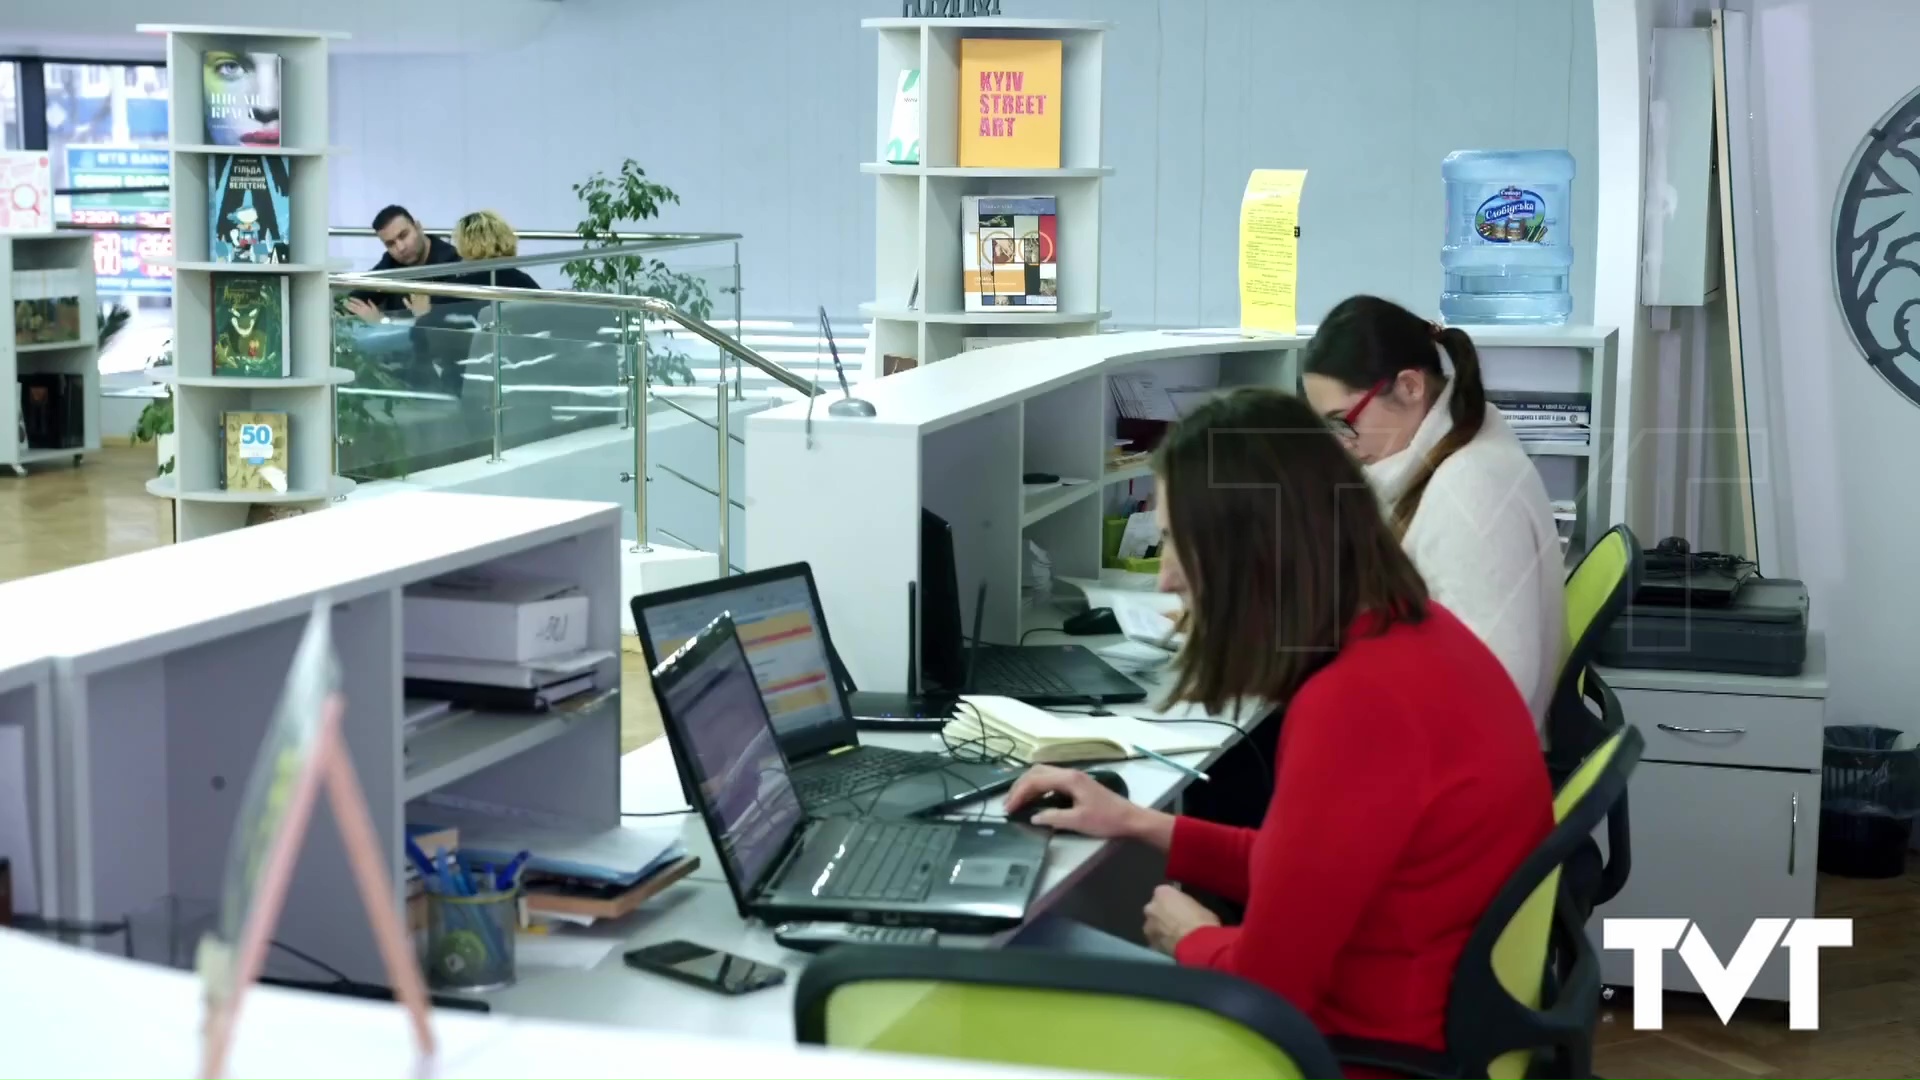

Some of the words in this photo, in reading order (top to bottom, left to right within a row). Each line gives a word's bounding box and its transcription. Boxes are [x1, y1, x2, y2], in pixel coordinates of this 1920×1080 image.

[980, 71, 1024, 91] KYIV
[980, 94, 1047, 115] STREET
[979, 117, 1016, 137] ART
[234, 165, 262, 174] ГІЛЬДА
[229, 182, 267, 190] ВЕЛЕТЕНЬ
[242, 425, 270, 445] 50
